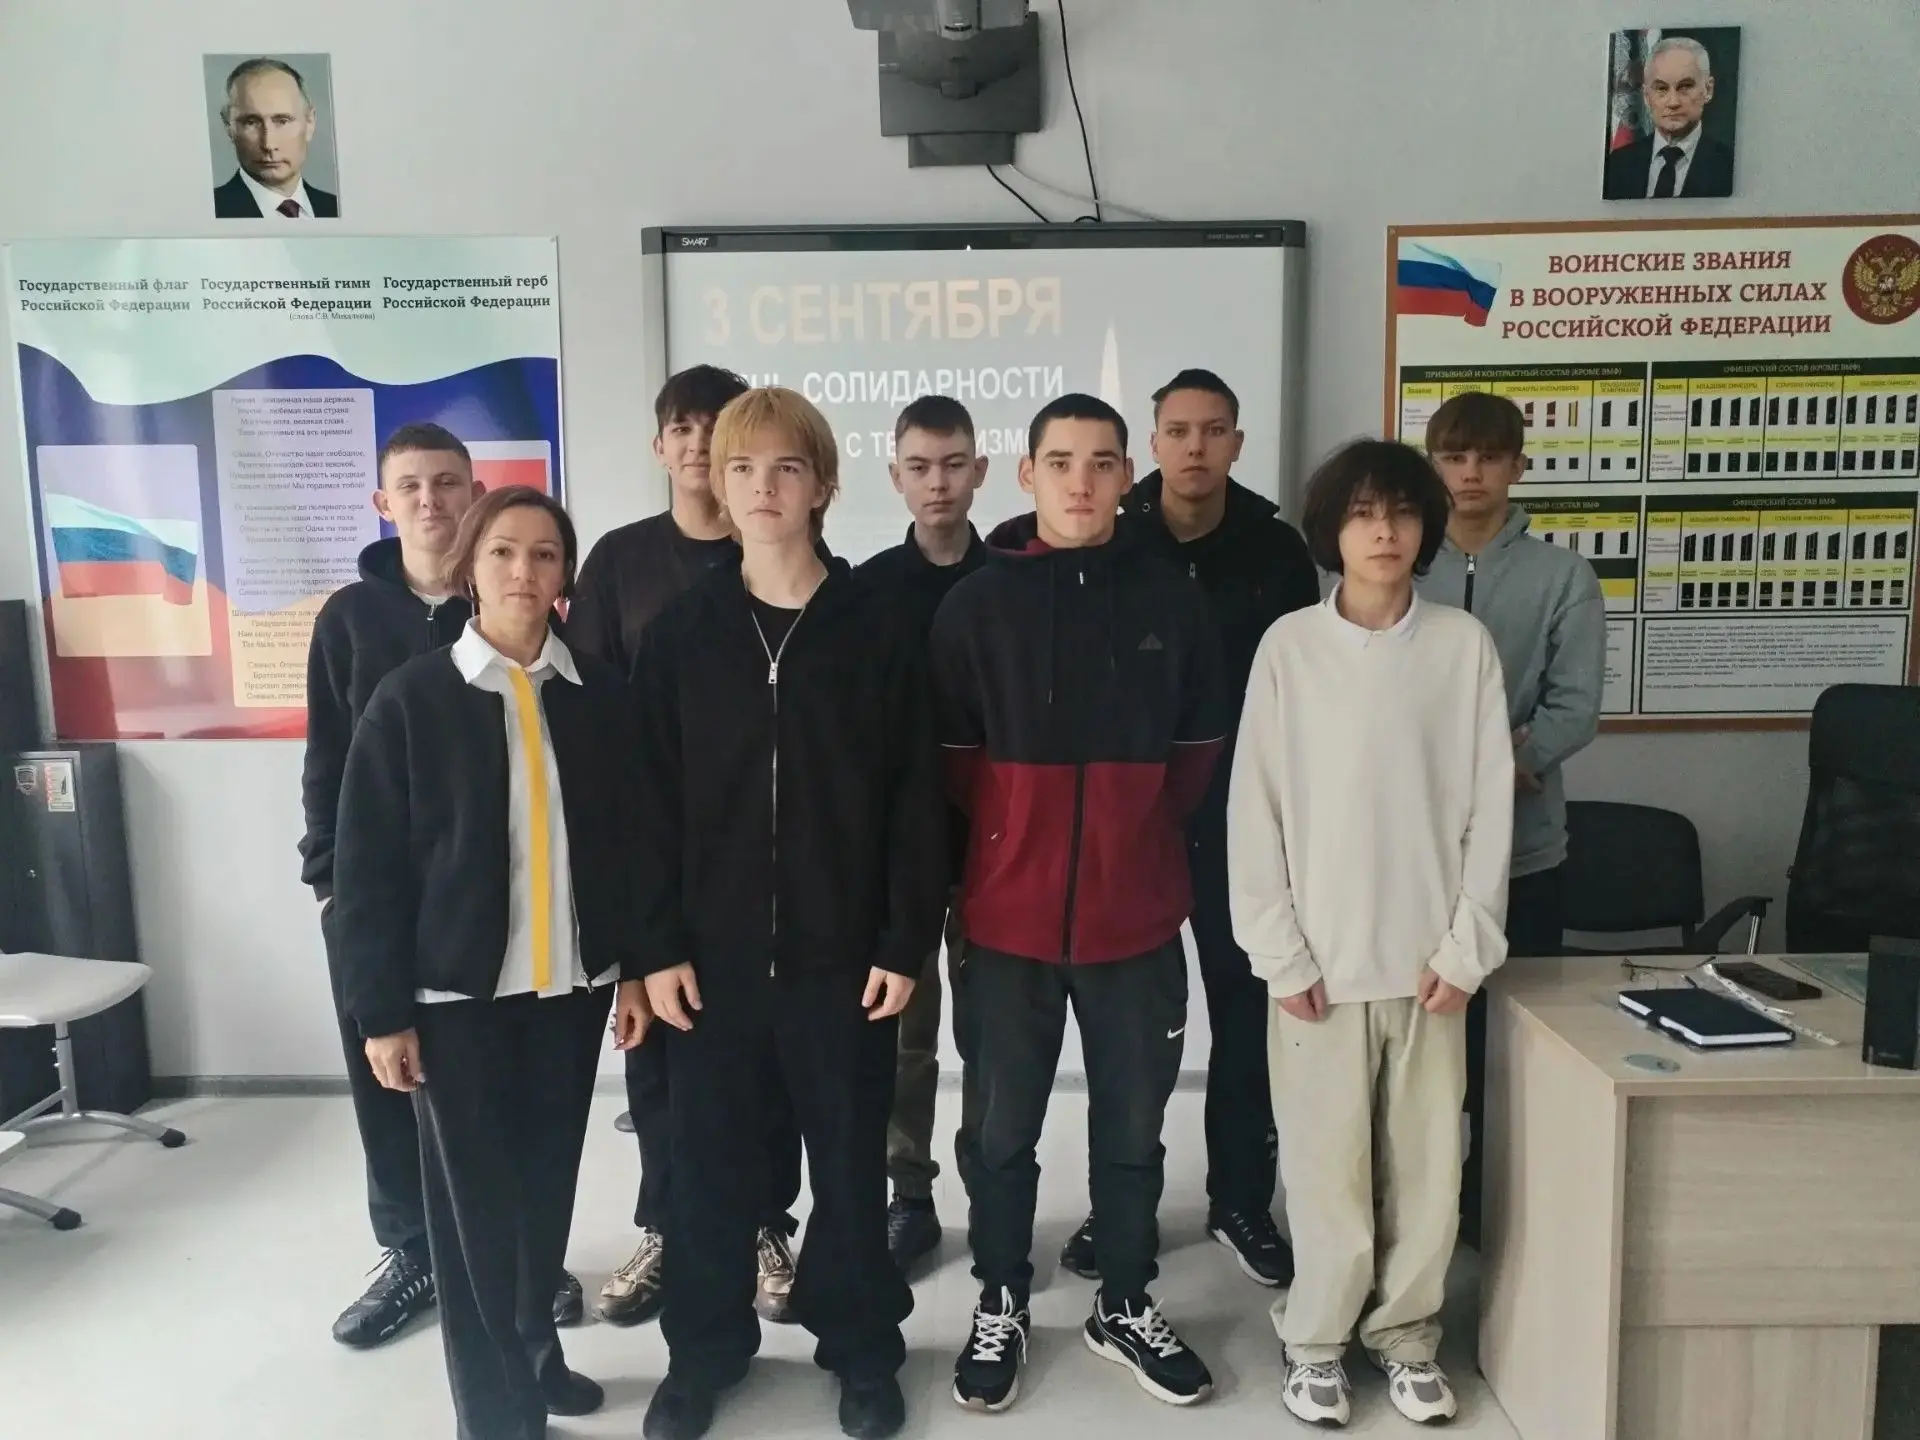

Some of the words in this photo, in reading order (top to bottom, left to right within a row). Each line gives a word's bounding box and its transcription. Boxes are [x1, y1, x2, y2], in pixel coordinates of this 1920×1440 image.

[681, 237, 709, 246] SMART
[1548, 253, 1685, 273] ВОИНСКИЕ
[1692, 250, 1791, 270] ЗВАНИЯ
[19, 278, 148, 294] Государственный
[152, 279, 190, 293] флаг
[200, 277, 330, 293] Государственный
[334, 280, 371, 290] гимн
[384, 275, 512, 291] Государственный
[516, 277, 549, 290] герб
[1510, 289, 1524, 306] В
[1532, 285, 1733, 306] ВООРУЖЕННЫХ
[1740, 282, 1827, 302] СИЛАХ
[21, 298, 104, 312] Российской
[109, 298, 191, 313] Федерации
[202, 298, 286, 311] Российской
[290, 297, 372, 312] Федерации
[383, 295, 466, 310] Российской
[470, 295, 551, 309] Федерации
[702, 286, 731, 348] 3
[749, 277, 1062, 346] СЕНТЯБРЯ
[1502, 314, 1673, 339] РОССИЙСКОЙ
[1680, 314, 1832, 337] ФЕДЕРАЦИИ
[803, 365, 1064, 407] СОЛИДАРНОСТИ
[845, 431, 862, 458] С
